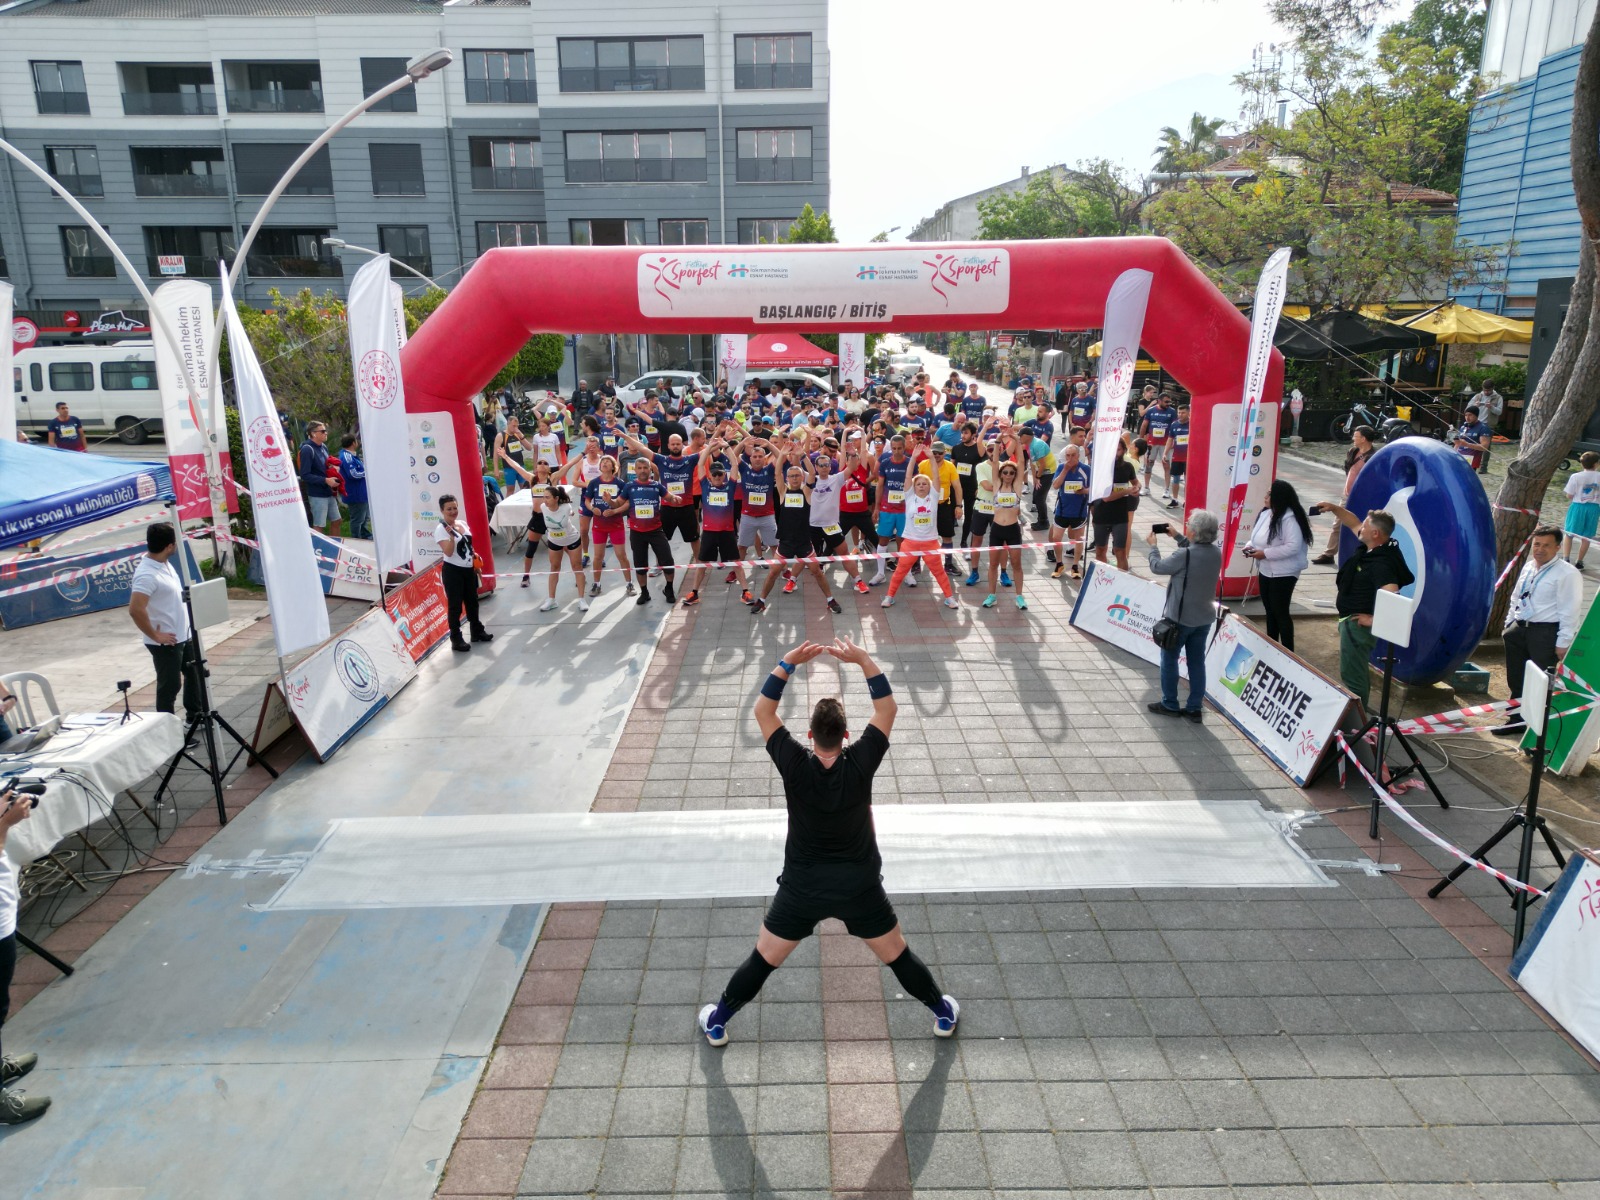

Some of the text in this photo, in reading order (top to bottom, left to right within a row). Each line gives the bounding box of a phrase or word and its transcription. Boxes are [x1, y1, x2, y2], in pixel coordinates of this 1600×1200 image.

[672, 260, 722, 286] Sporfest
[950, 256, 1001, 282] Sporfest
[760, 304, 837, 320] BAŞLANGIÇ
[850, 302, 888, 320] BİTİŞ
[90, 320, 134, 332] Pizza Hut
[190, 306, 208, 388] ESNAF HASTANESİ
[0, 486, 134, 536] LİK VE SPOR İL MÜDÜRLÜĞÜ
[347, 566, 372, 576] C'EST
[1130, 608, 1158, 624] lokmanh
[1142, 626, 1152, 634] HAS
[1250, 660, 1313, 720] FETHİYE
[1240, 681, 1301, 742] BELEDİYESİ
